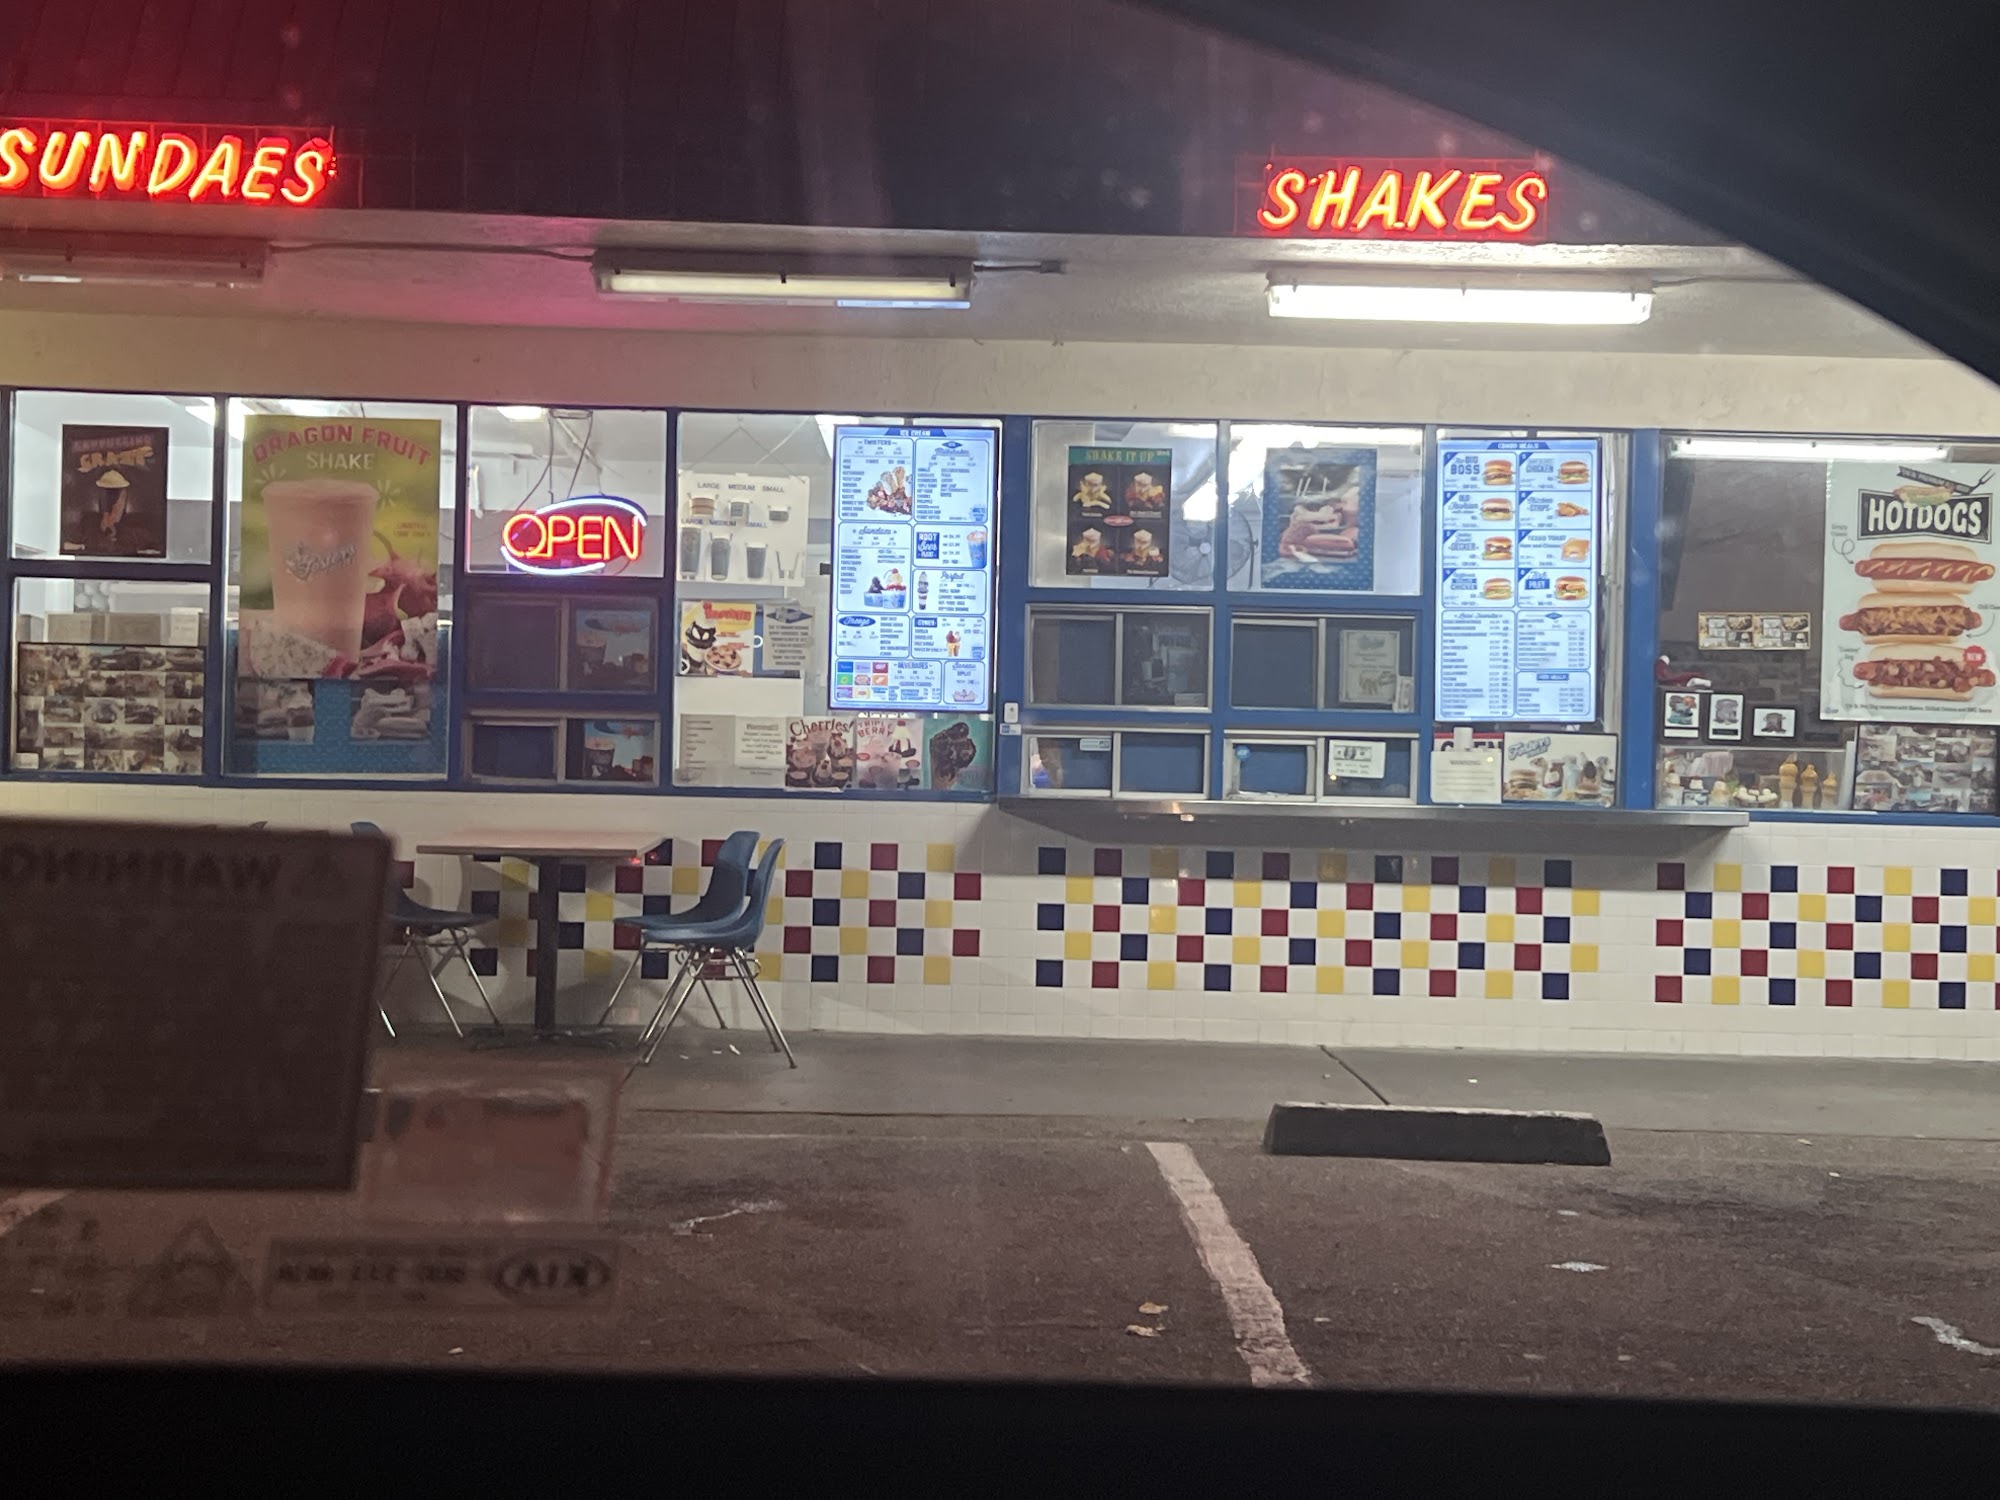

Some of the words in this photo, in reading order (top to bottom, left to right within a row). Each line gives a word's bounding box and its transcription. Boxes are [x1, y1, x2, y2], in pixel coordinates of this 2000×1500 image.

[0, 127, 334, 202] SUNDAES
[1257, 166, 1548, 232] SHAKES
[252, 425, 353, 463] DRAGON
[362, 428, 431, 465] FRUIT
[306, 453, 375, 470] SHAKE
[1086, 450, 1122, 461] SHAKE
[1126, 450, 1136, 461] IT
[1140, 451, 1154, 462] UP
[1450, 464, 1480, 475] BOSS
[1868, 497, 1983, 536] HOTDOGS
[502, 513, 641, 560] OPEN
[919, 533, 937, 541] ROOT
[1967, 652, 1981, 661] NEW
[790, 718, 856, 741] Cherries!
[858, 720, 893, 730] TRIPLE
[858, 727, 893, 738] BERRY
